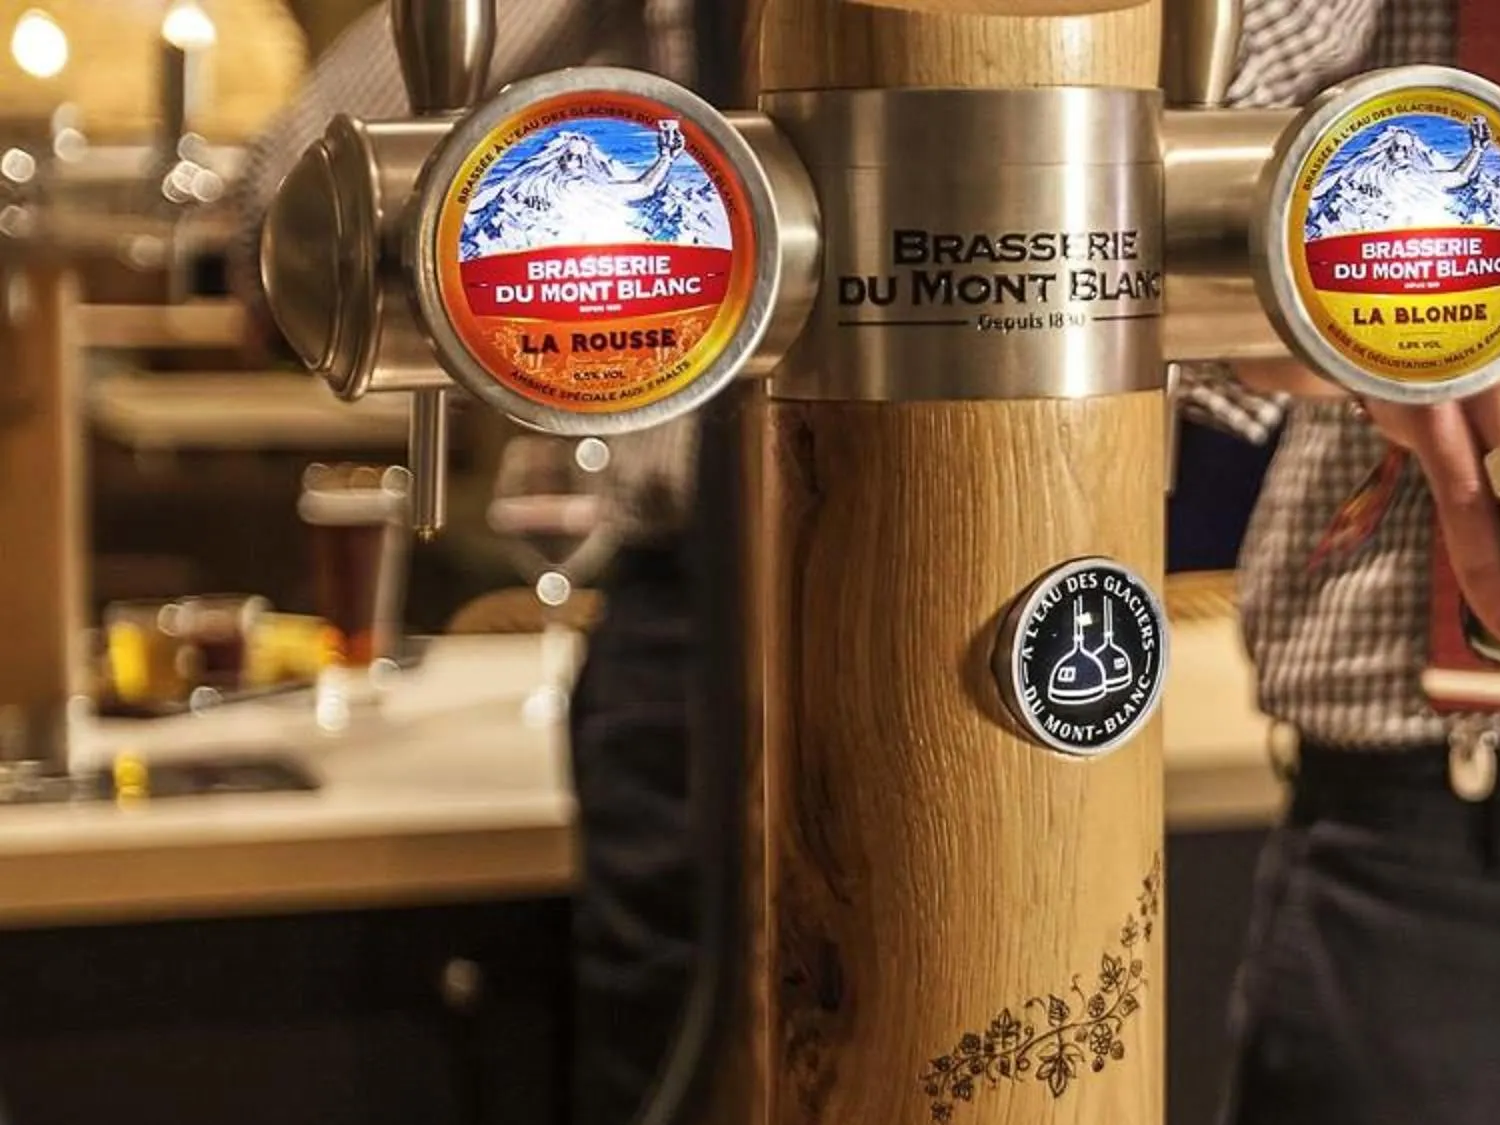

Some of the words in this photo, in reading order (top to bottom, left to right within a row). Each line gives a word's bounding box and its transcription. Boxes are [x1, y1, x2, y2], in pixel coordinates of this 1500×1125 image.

[894, 230, 1137, 265] BRASSERIE
[1361, 238, 1482, 259] BRASSERIE
[527, 256, 671, 280] BRASSERIE
[1334, 263, 1366, 279] DU
[1373, 261, 1433, 279] MONT
[496, 285, 534, 304] DU
[541, 280, 613, 303] MONT
[617, 276, 702, 300] BLANC
[838, 275, 897, 306] DU
[911, 271, 1056, 306] MONT
[1069, 269, 1161, 301] BLANC
[977, 312, 1043, 335] Depuis
[1353, 307, 1385, 325] LA
[1394, 303, 1487, 323] BLONDE
[521, 334, 560, 353] LA
[571, 328, 677, 352] ROUSSE
[1026, 586, 1063, 639] L'EAU
[1066, 572, 1098, 593] DES
[1104, 575, 1155, 651] GLACIERS
[1024, 685, 1045, 716] DU
[1043, 674, 1151, 741] MONT-BLANC
